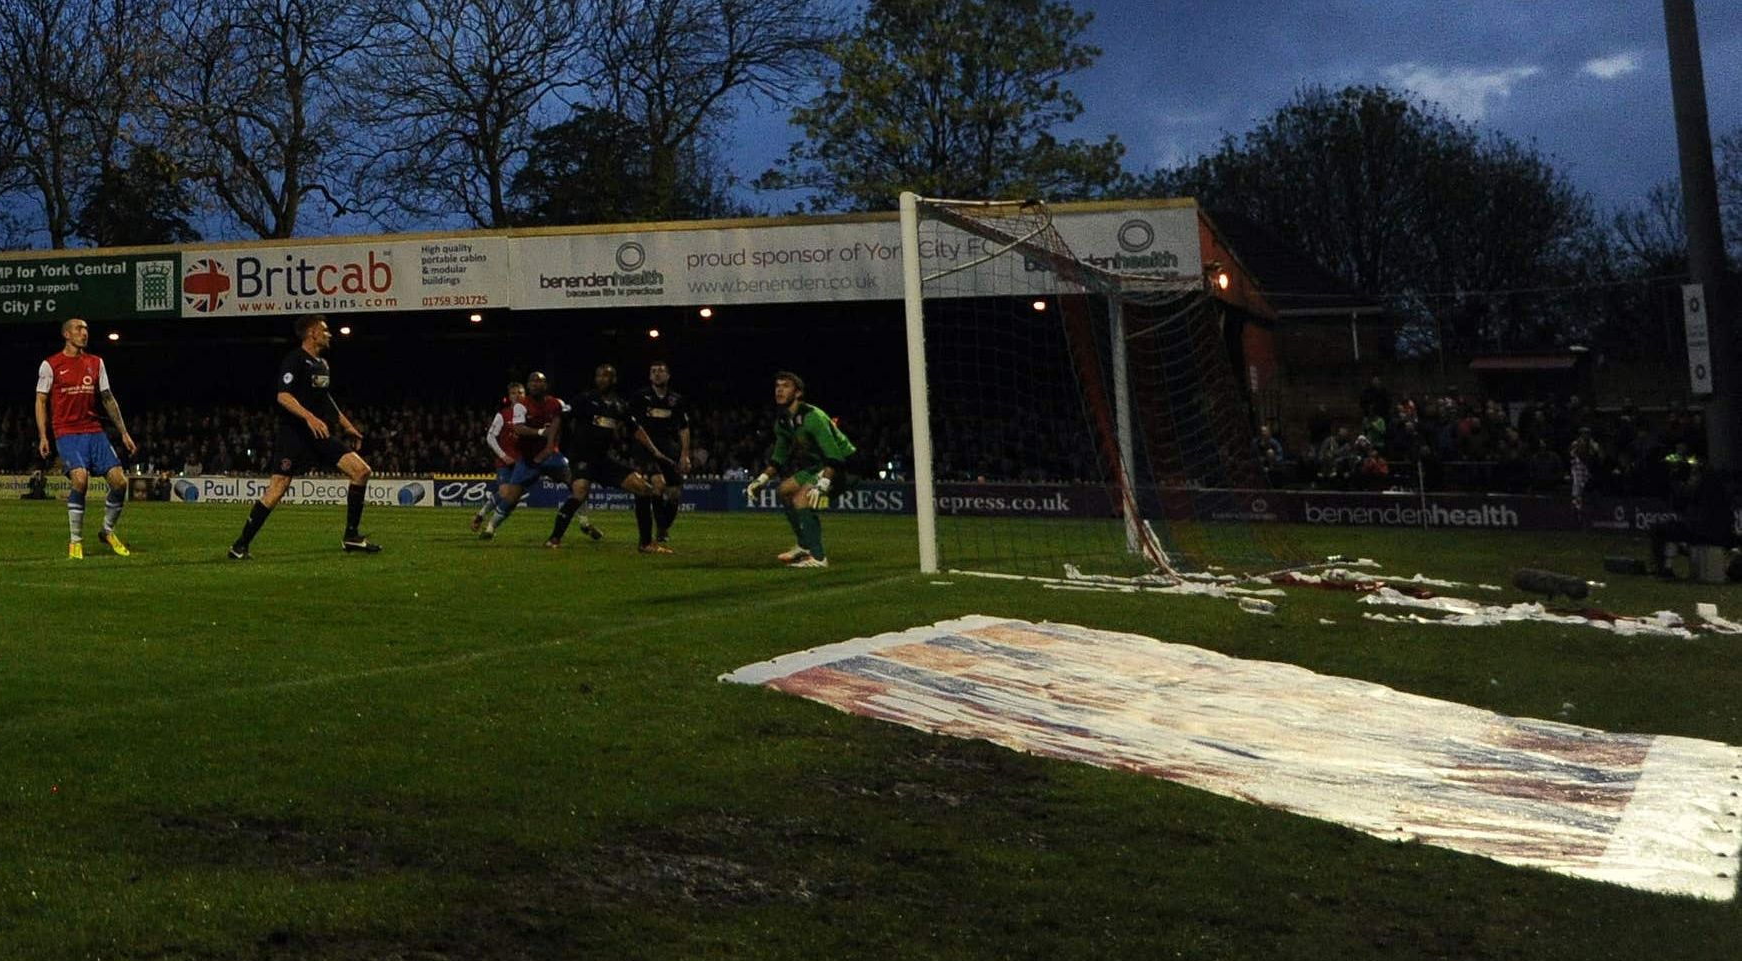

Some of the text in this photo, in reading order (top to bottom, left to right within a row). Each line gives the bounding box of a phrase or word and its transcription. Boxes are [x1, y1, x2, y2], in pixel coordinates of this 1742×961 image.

[421, 244, 473, 255] High quality
[686, 248, 746, 271] proud
[752, 246, 834, 269] sponsor
[839, 242, 862, 261] of
[864, 242, 902, 261] Yor
[917, 238, 961, 262] City
[421, 253, 487, 265] portable cabins
[16, 266, 36, 279] for
[40, 264, 71, 278] York
[74, 261, 127, 276] Central
[236, 251, 393, 298] Britcab
[431, 265, 467, 274] modular
[36, 282, 80, 294] supports
[422, 275, 461, 286] buildings
[539, 270, 664, 289] benendenhealth
[687, 273, 878, 295] www.benenden.co.uk
[2, 300, 30, 315] City
[33, 299, 43, 312] F
[45, 298, 57, 312] C
[238, 297, 399, 313] www.ukcabins.com
[422, 295, 488, 307] 01759 301725
[203, 479, 240, 497] Paul
[301, 480, 393, 501] Decotor
[1305, 501, 1520, 527] benendenhealth
